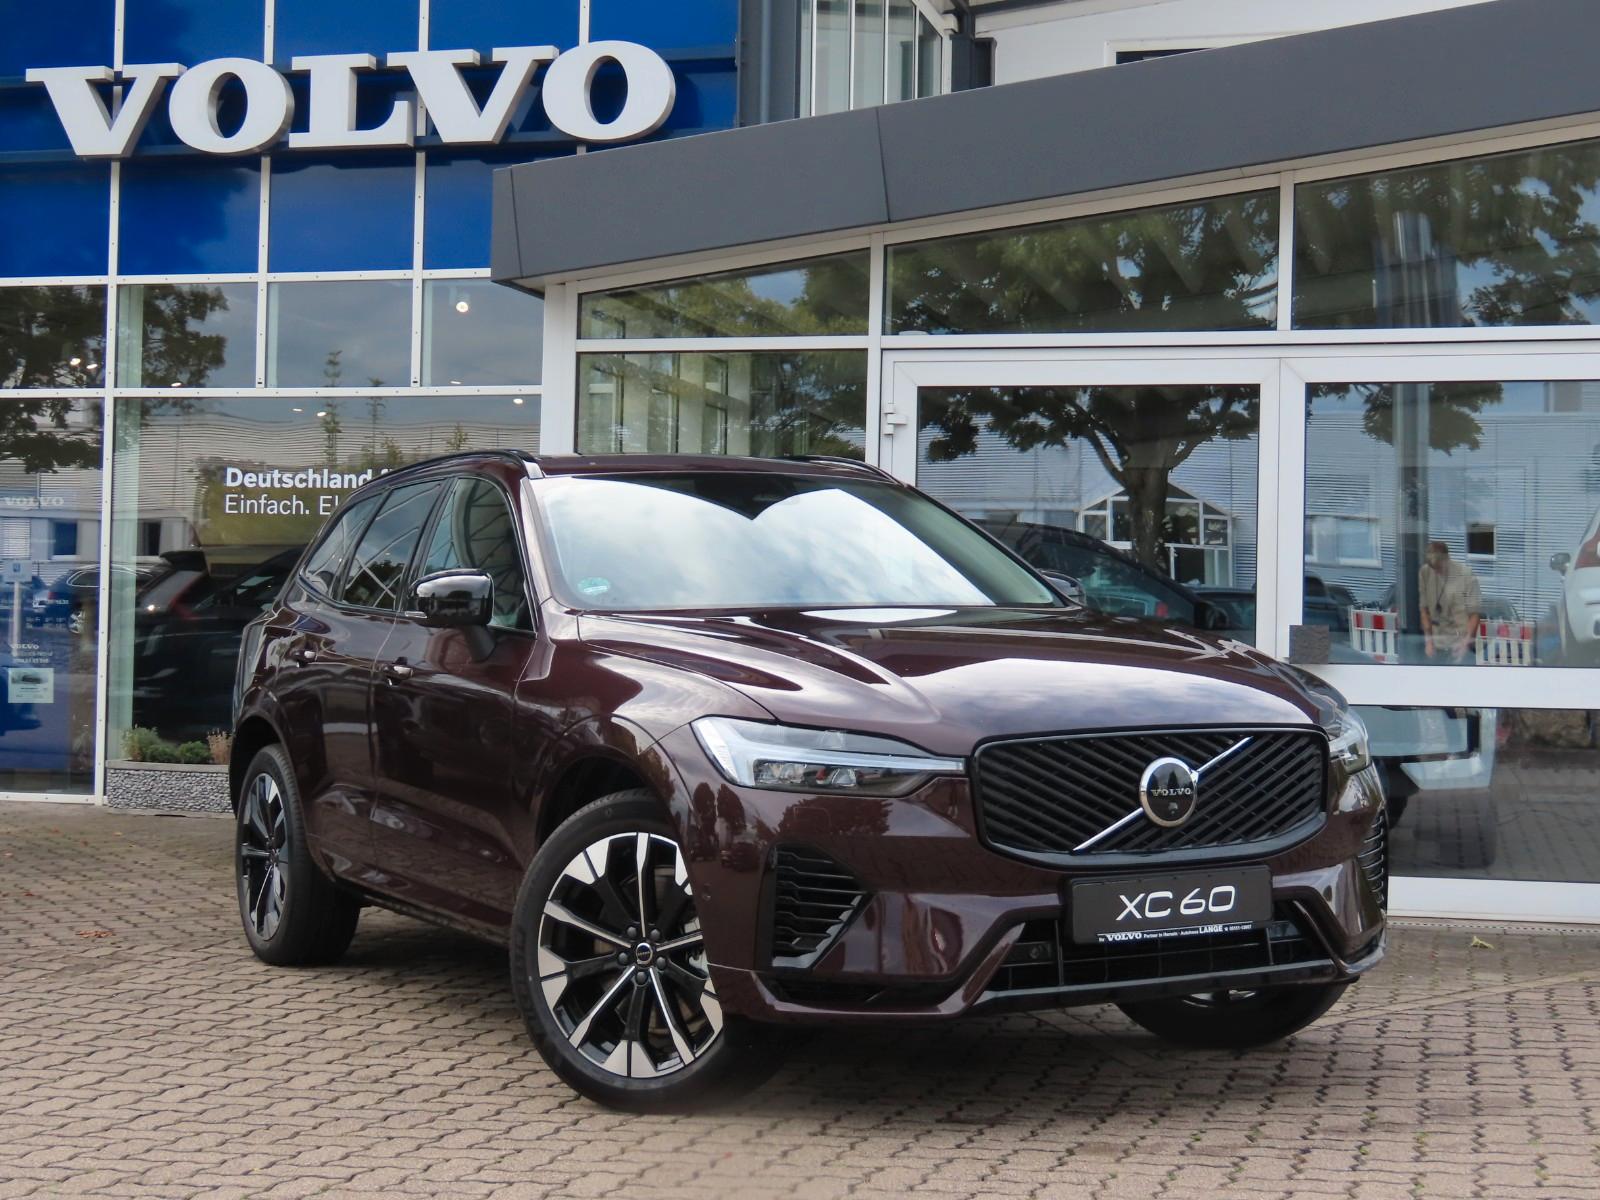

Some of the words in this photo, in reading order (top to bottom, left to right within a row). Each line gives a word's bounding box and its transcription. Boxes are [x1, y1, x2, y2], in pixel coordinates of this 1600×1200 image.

[26, 40, 676, 158] VOLVO
[225, 467, 372, 489] Deutschland
[224, 494, 310, 515] Einfach.
[1151, 787, 1192, 797] VOLVO
[1106, 931, 1142, 942] VOLVO
[1199, 925, 1223, 934] LANGE
